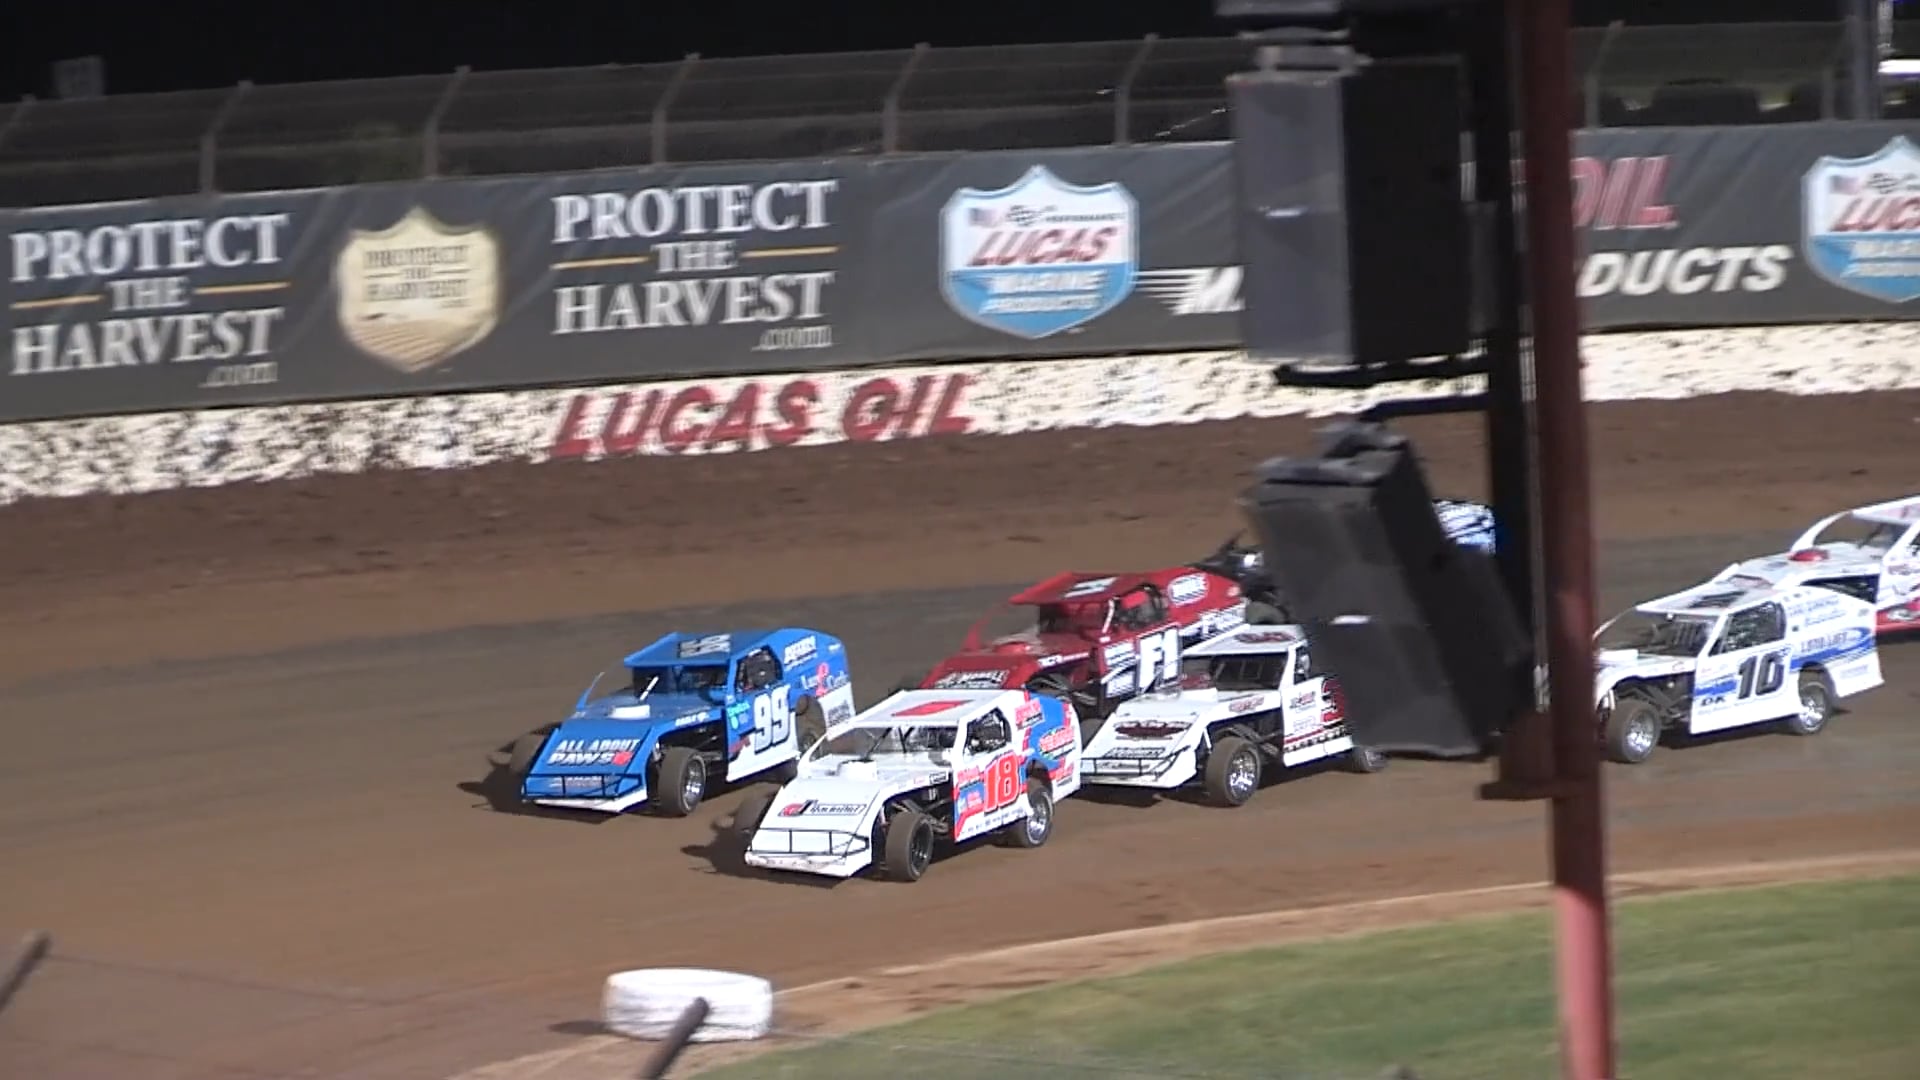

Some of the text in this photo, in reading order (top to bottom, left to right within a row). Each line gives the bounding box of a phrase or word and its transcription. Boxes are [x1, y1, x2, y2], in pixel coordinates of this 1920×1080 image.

[552, 180, 838, 244] PROTECT
[9, 213, 292, 283] PROTECT
[650, 240, 738, 273] THE
[968, 226, 1118, 267] LUCAS
[1576, 245, 1794, 298] DUCTS
[106, 276, 191, 312] THE
[552, 271, 836, 335] HARVEST
[9, 307, 285, 375] HARVEST
[550, 373, 977, 458] LUCAS OIL
[1737, 651, 1785, 700] 10
[555, 738, 641, 752] ALL ABOUT
[754, 684, 791, 755] 99
[546, 752, 616, 767] PAWS
[984, 751, 1020, 816] 18
